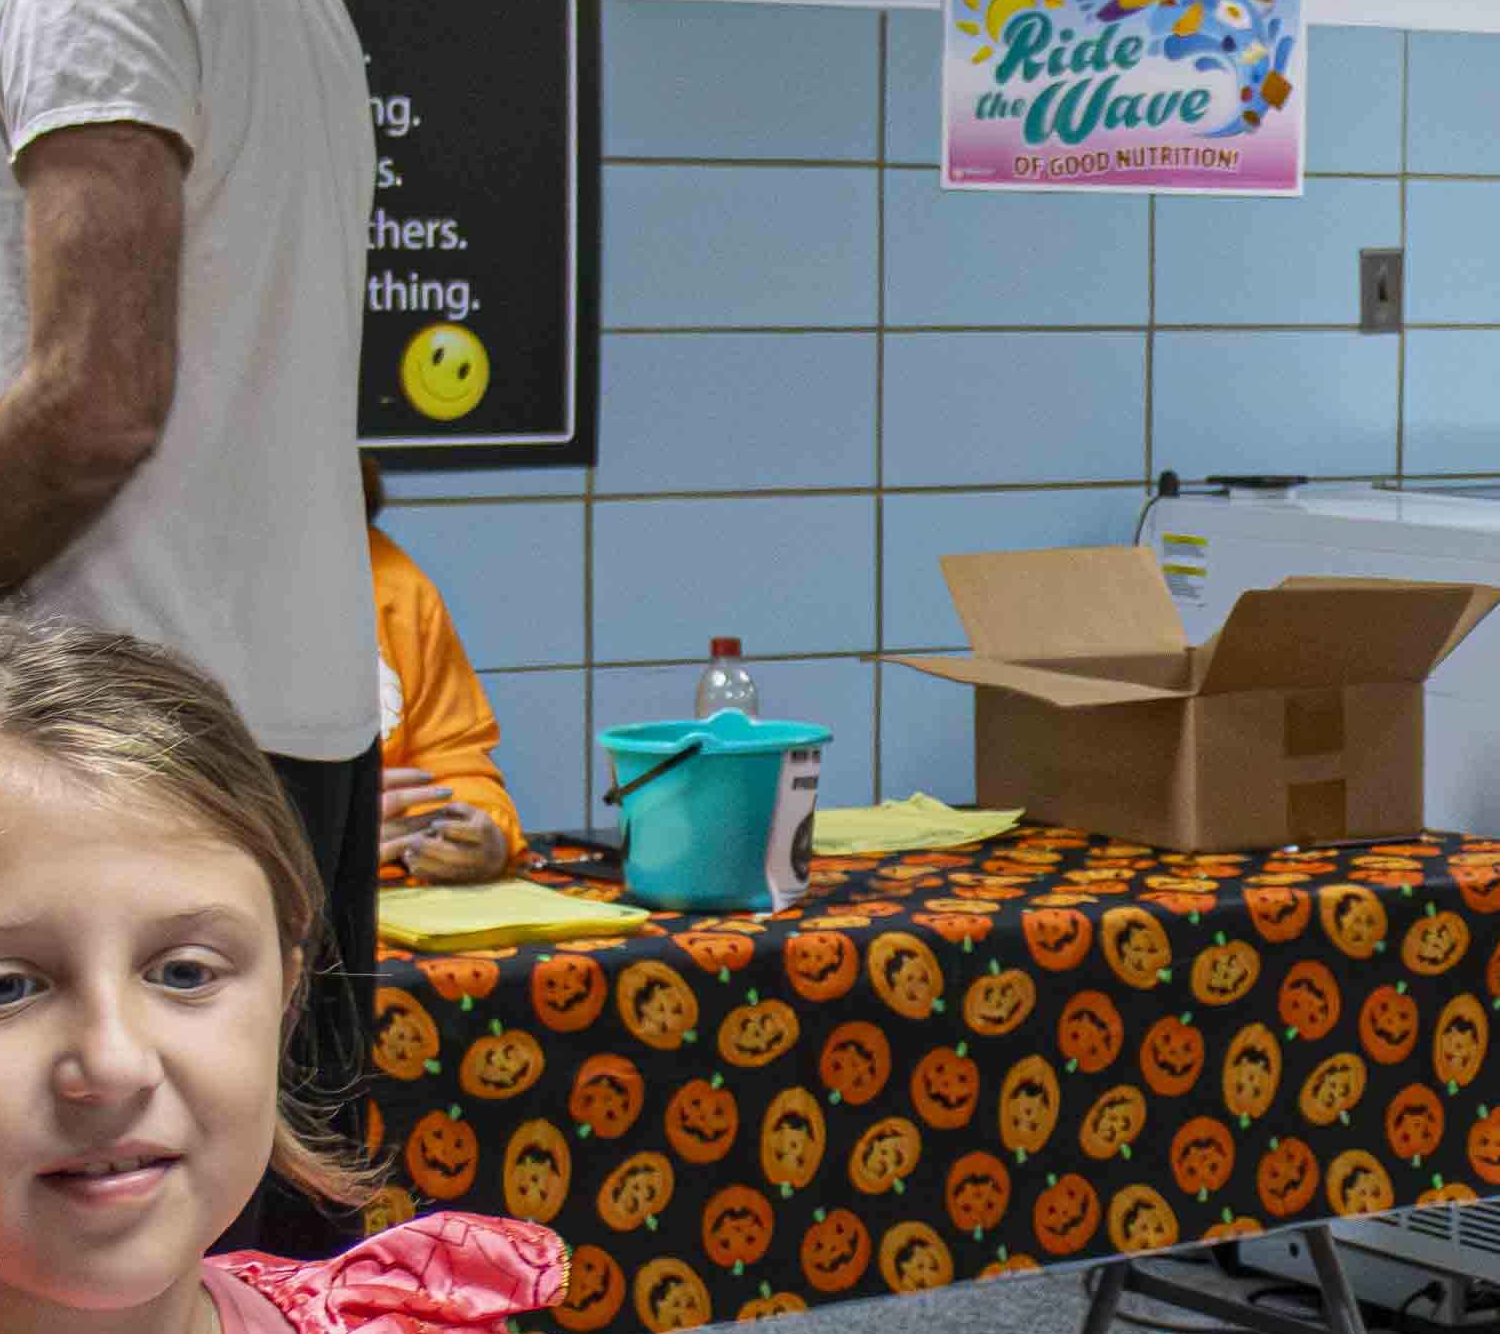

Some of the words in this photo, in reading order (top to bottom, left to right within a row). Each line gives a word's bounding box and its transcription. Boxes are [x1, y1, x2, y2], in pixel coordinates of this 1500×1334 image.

[994, 10, 1144, 83] Ride
[975, 91, 1026, 122] the
[1023, 75, 1212, 145] Wave
[1014, 155, 1044, 177] OF
[1050, 151, 1110, 177] GOOD
